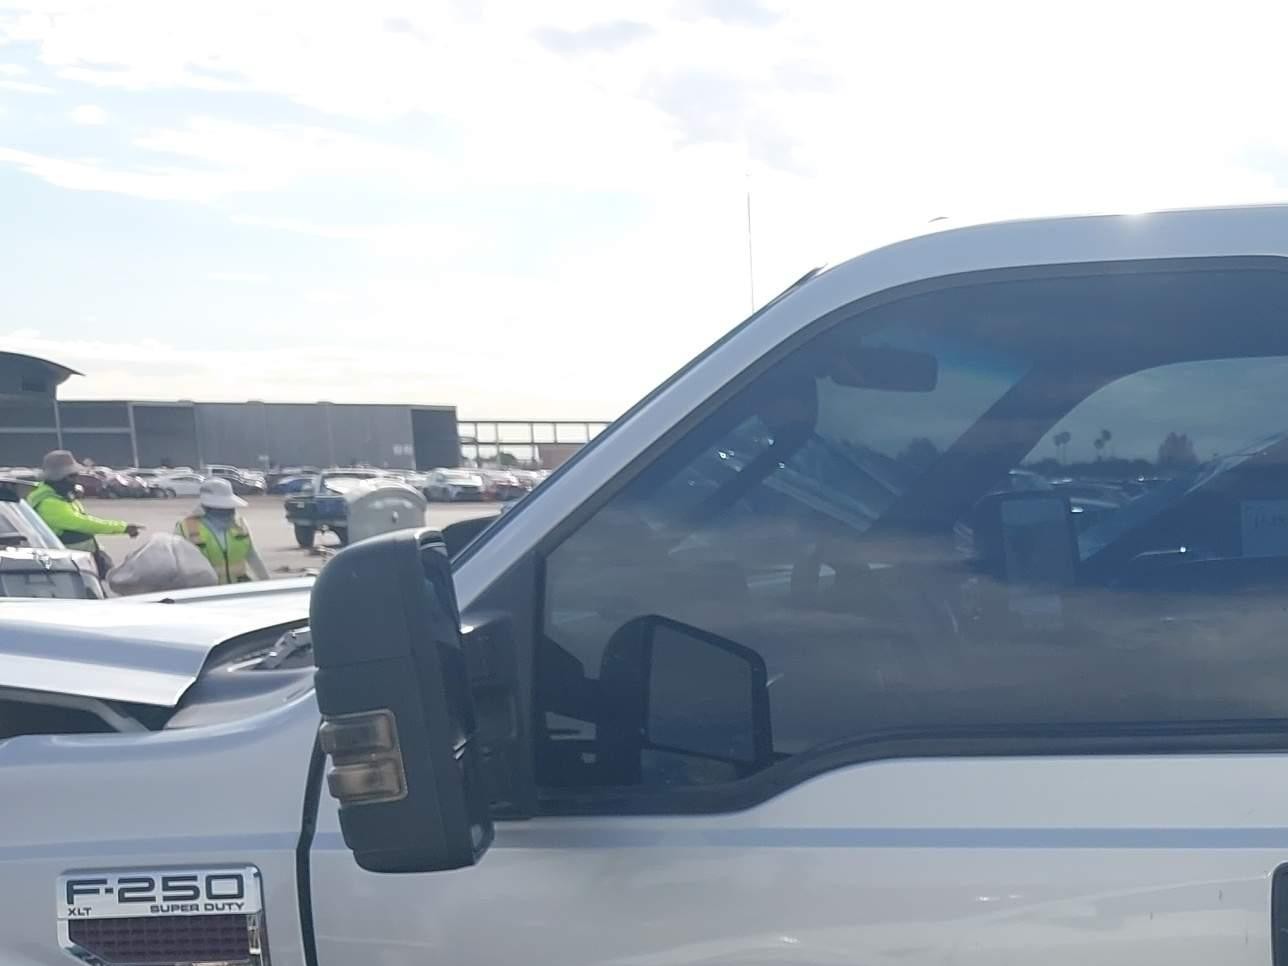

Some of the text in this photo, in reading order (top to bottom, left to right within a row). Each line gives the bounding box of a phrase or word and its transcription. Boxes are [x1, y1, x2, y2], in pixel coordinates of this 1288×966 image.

[66, 873, 245, 905] F-250
[68, 907, 92, 917] XLT
[150, 902, 245, 914] SUPER DUTY
